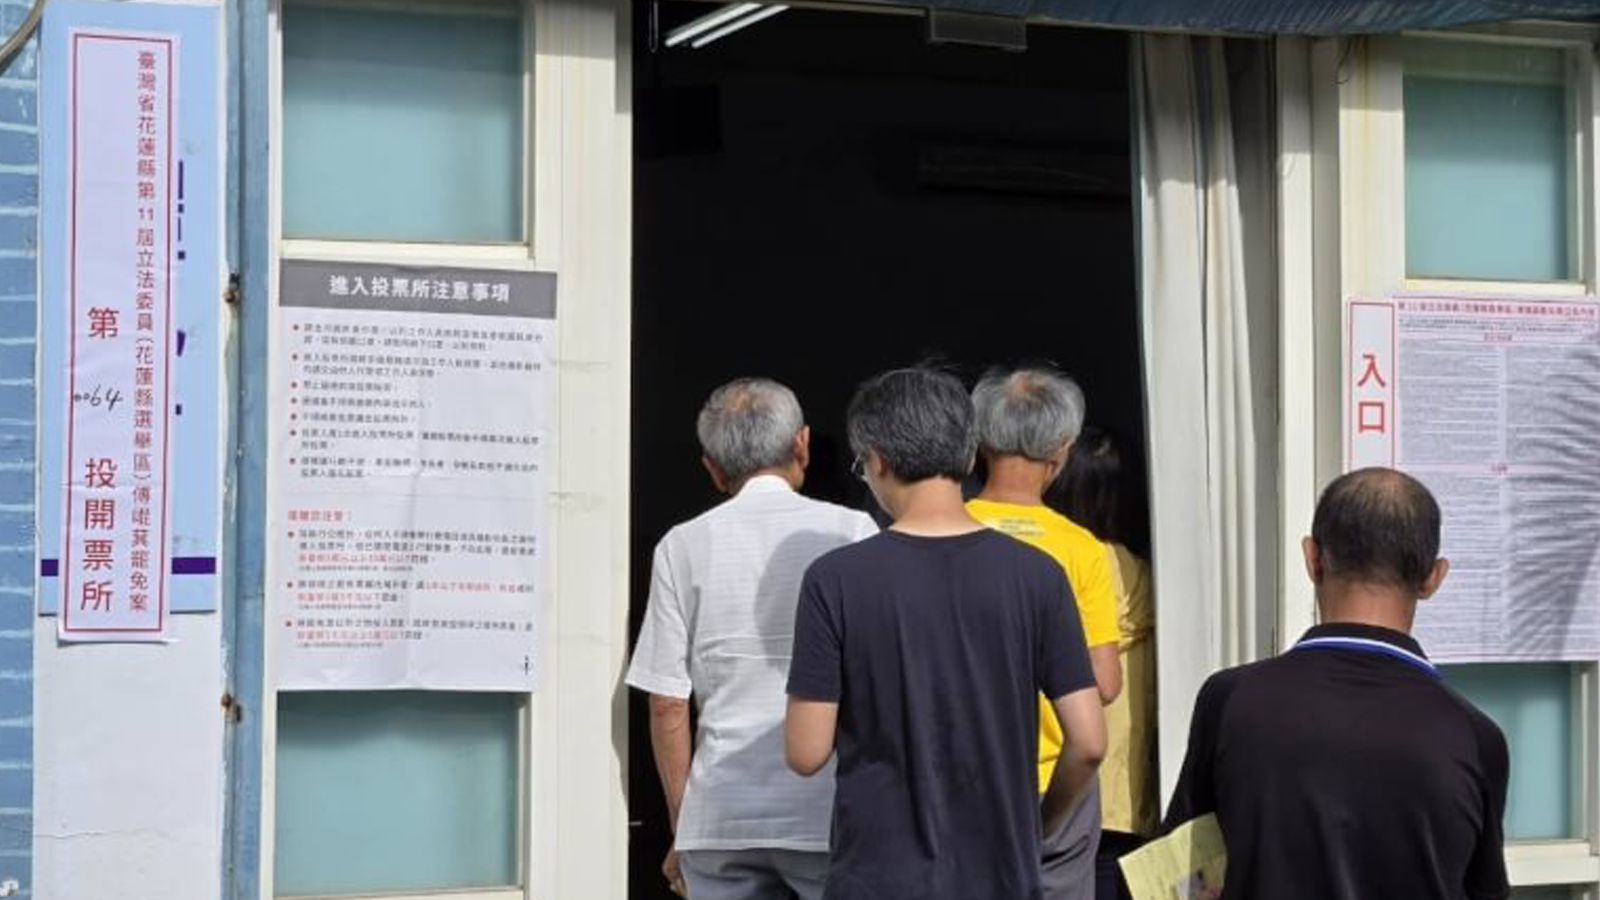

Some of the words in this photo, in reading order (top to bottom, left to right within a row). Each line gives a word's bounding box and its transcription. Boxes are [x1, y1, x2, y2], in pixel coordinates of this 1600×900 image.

[328, 273, 510, 304] 進入投票所注意事項
[87, 306, 120, 339] 第
[1357, 353, 1386, 434] 入口
[80, 457, 118, 612] 投開票所
